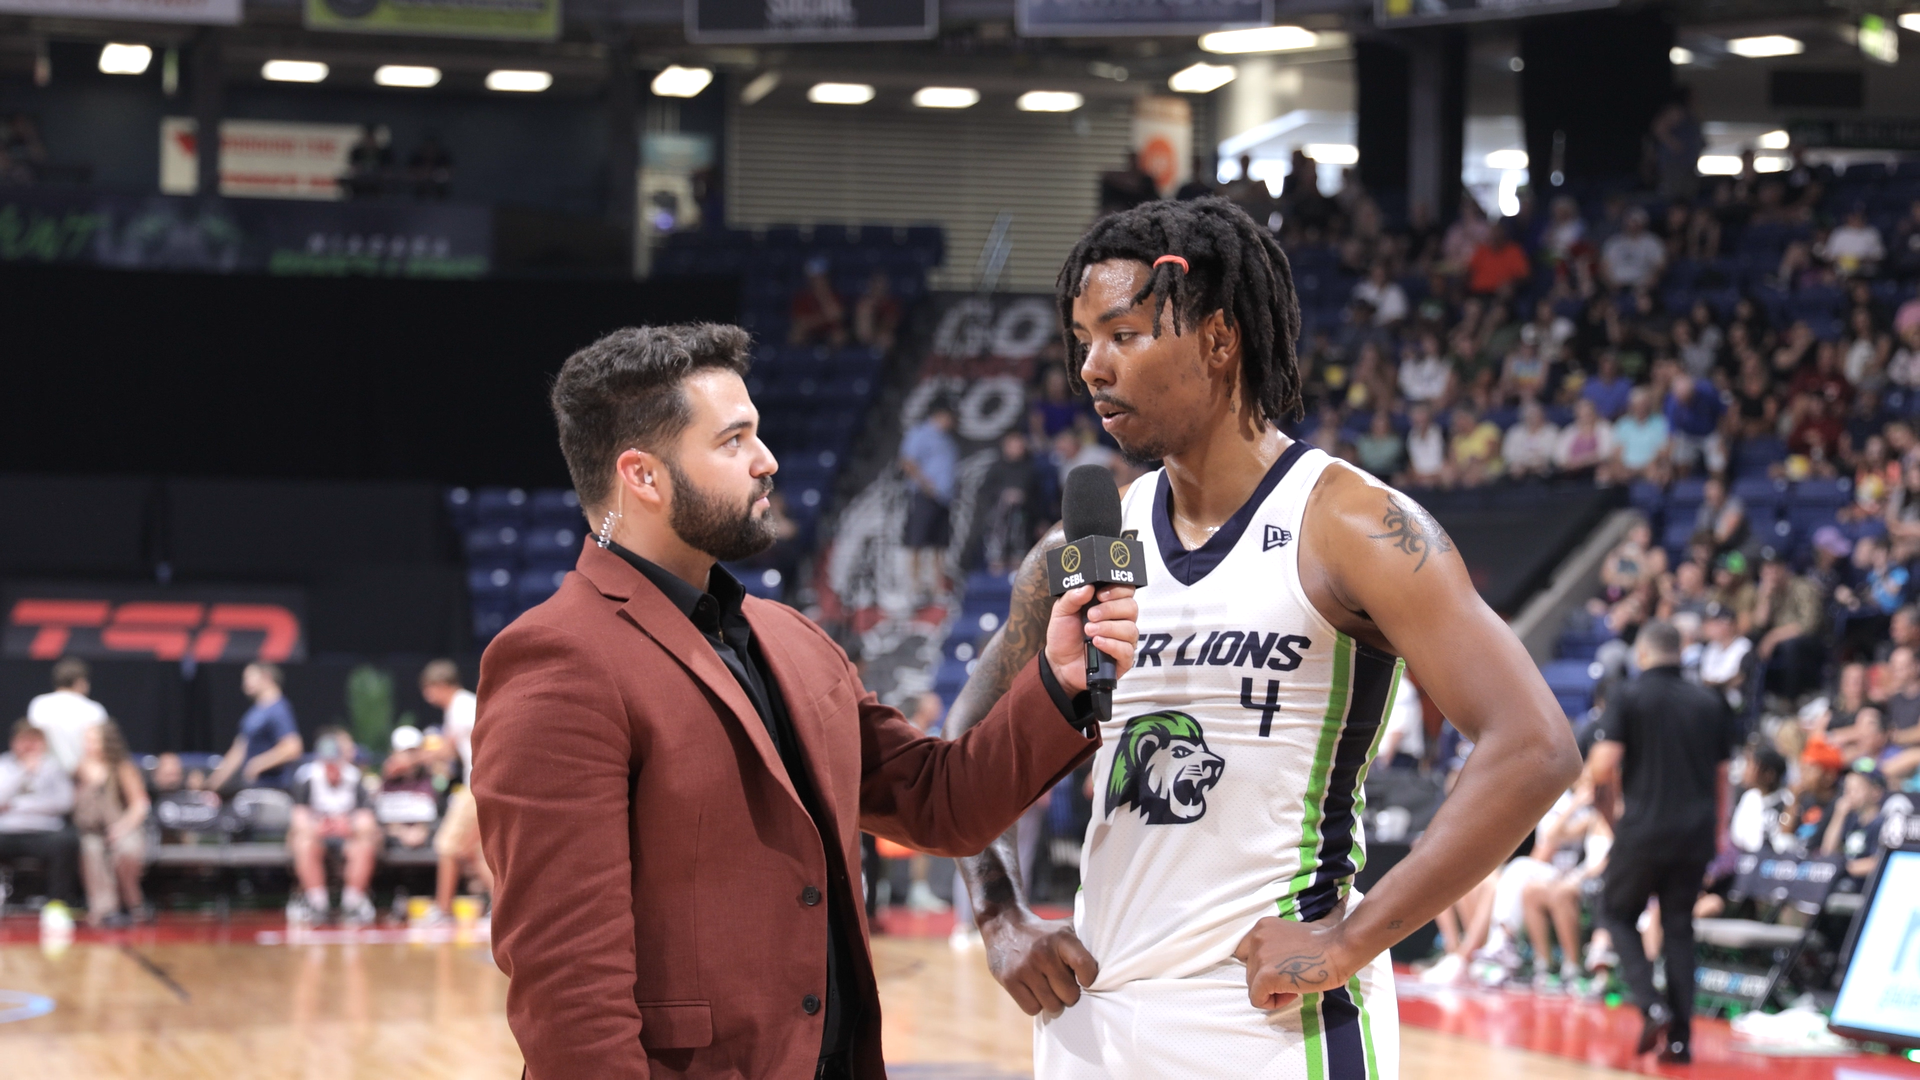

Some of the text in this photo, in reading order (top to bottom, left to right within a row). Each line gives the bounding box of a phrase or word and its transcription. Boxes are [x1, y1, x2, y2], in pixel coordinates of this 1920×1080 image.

[934, 298, 1055, 358] GO
[1062, 572, 1085, 588] CEBL
[1110, 569, 1134, 582] LECB
[10, 598, 299, 662] TSN
[1173, 631, 1312, 672] LIONS
[1240, 677, 1281, 737] 4
